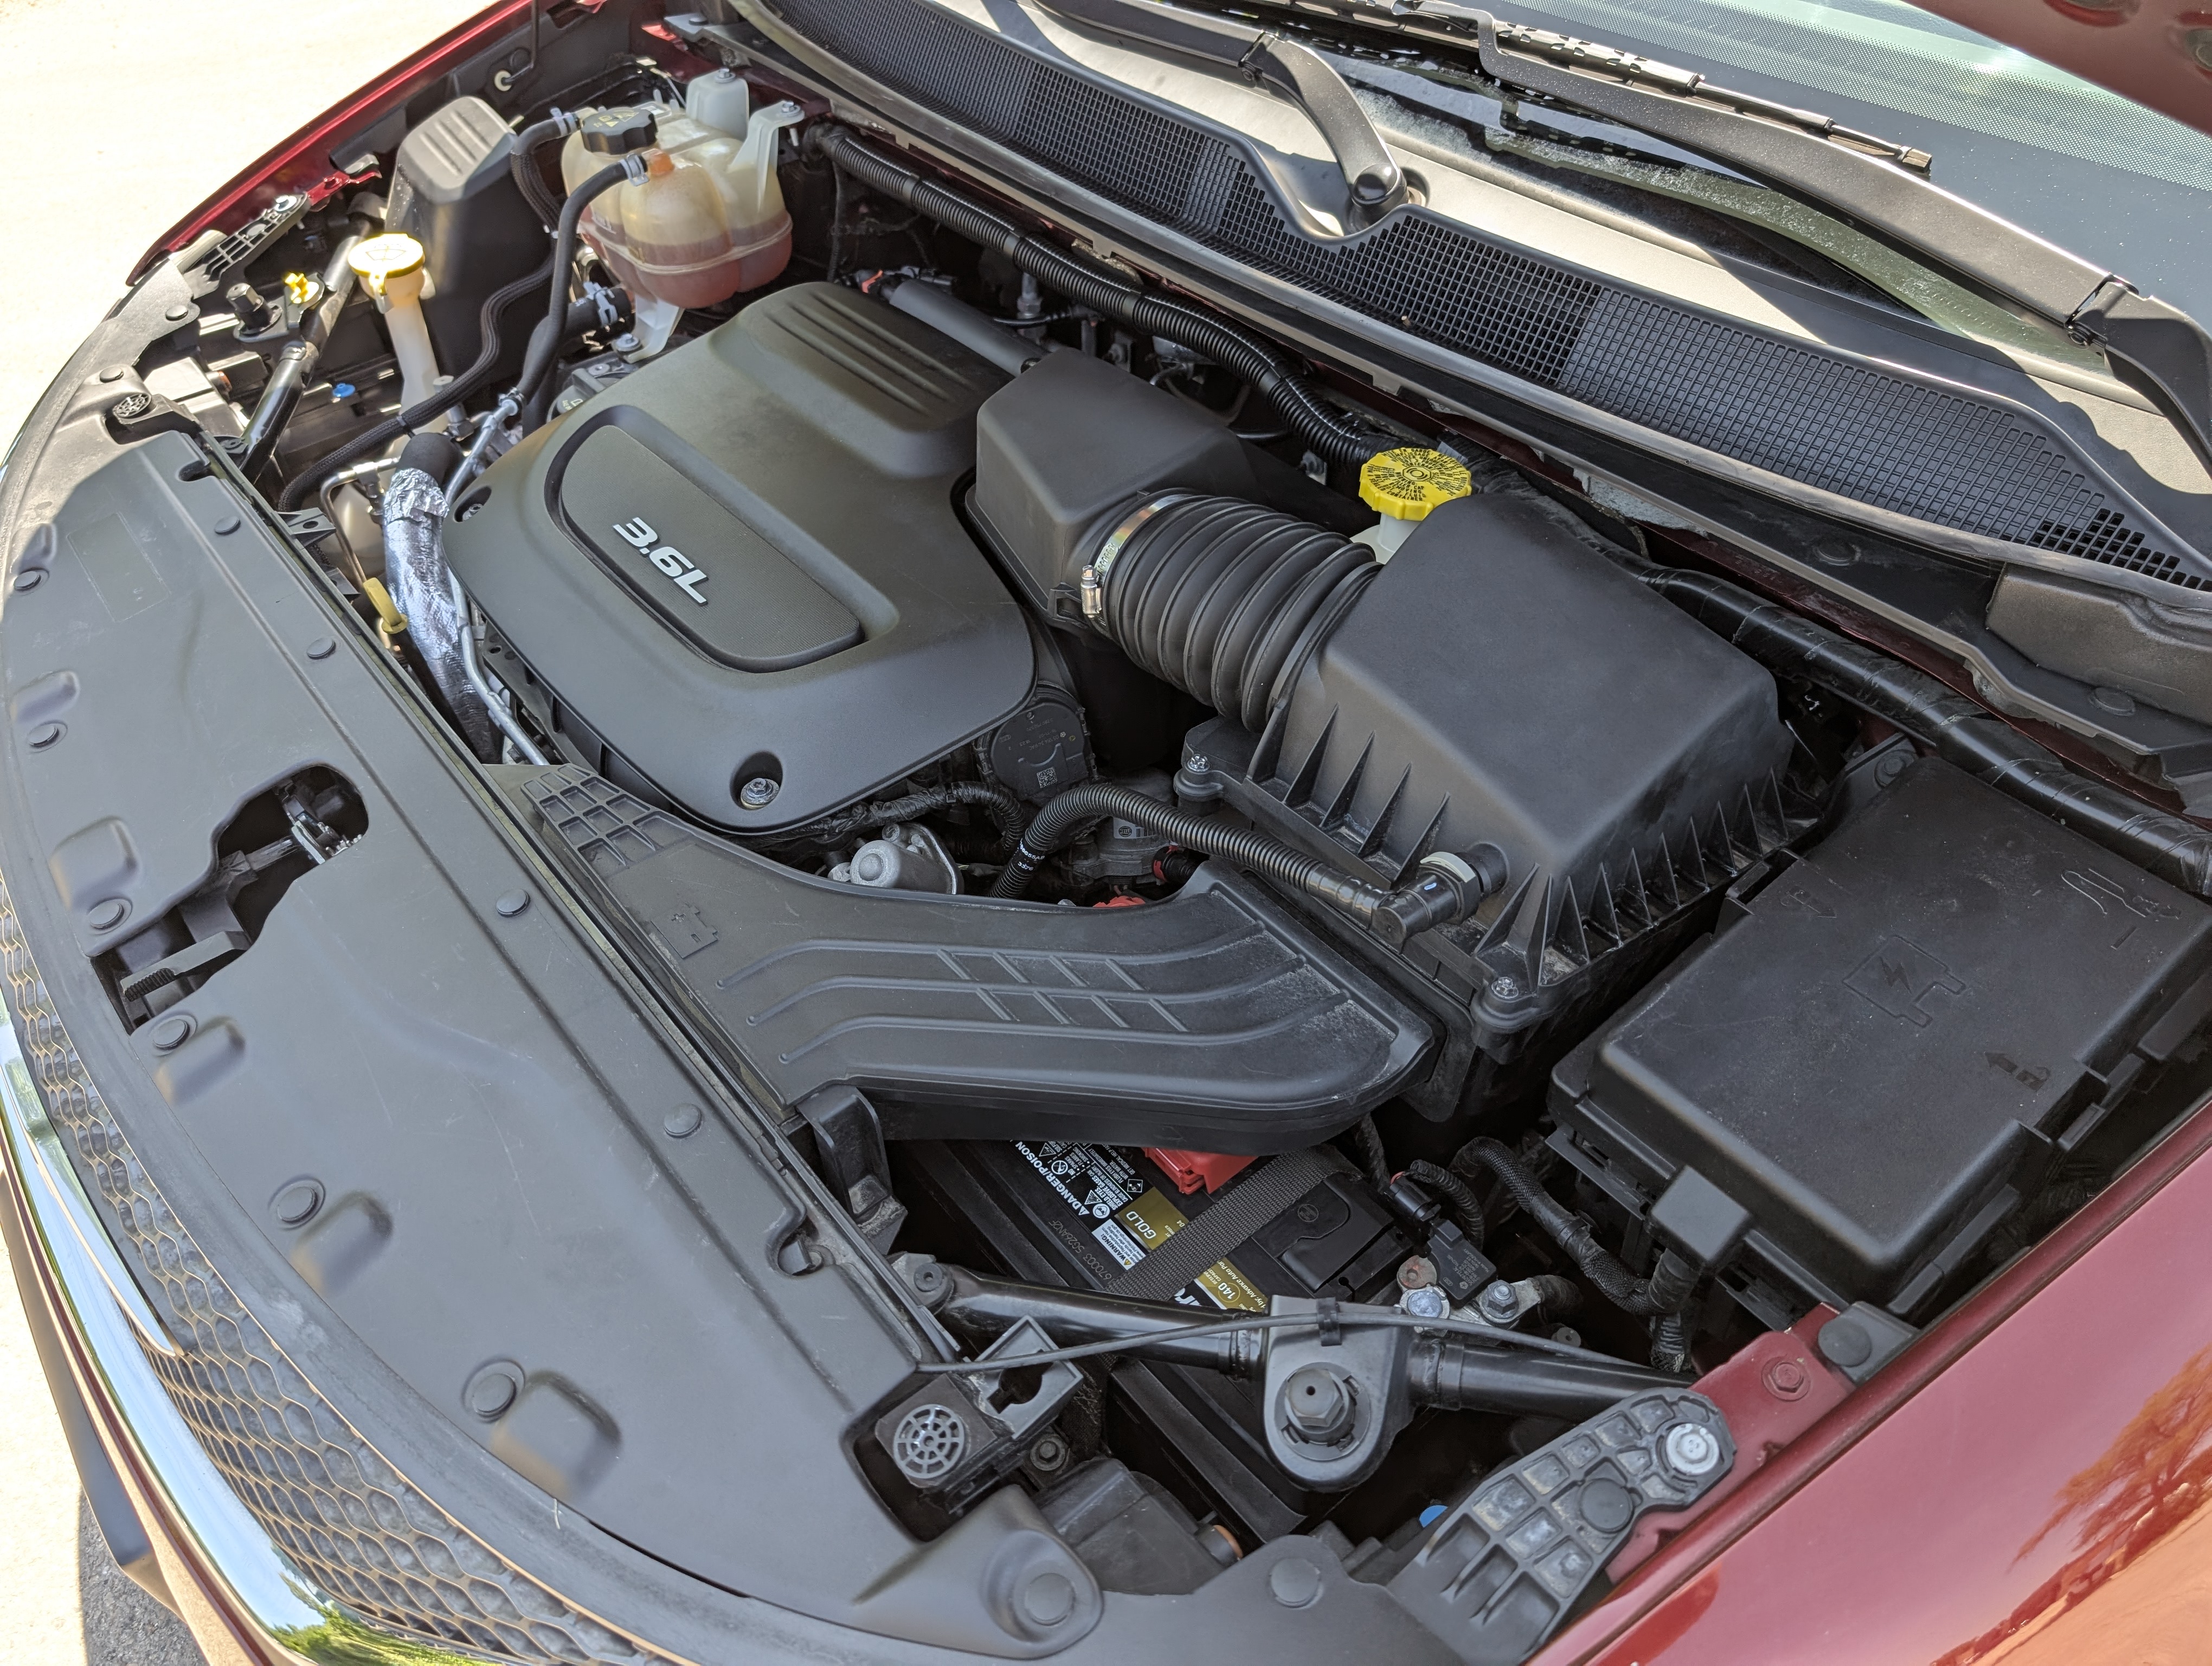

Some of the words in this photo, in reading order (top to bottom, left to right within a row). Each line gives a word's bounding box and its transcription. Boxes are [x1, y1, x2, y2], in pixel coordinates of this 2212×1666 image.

[612, 516, 709, 606] 3.6L
[1069, 1151, 1084, 1167] FLAMES
[1072, 1145, 1089, 1162] SMOKING
[1087, 1146, 1108, 1168] IMMEDIATELY
[1107, 1148, 1118, 1158] HELP
[1064, 1155, 1079, 1170] SPARKS
[1104, 1164, 1115, 1175] EYES
[1114, 1155, 1130, 1170] MEDICAL
[1014, 1139, 1083, 1210] DANGER/POISON
[1066, 1167, 1076, 1176] NO
[1086, 1168, 1095, 1177] CAN
[1111, 1171, 1124, 1184] FLUSH
[1117, 1169, 1129, 1180] WITH
[1126, 1166, 1136, 1176] GET
[1091, 1174, 1105, 1189] GASES
[1103, 1177, 1120, 1194] BLINDNESS
[1102, 1185, 1123, 1207] EXPLOSIVE
[1103, 1195, 1118, 1211] SHIELD
[1117, 1191, 1129, 1203] CAUSE
[1124, 1208, 1158, 1241] GOLD
[1099, 1232, 1127, 1261] WARNING:
[1108, 1234, 1126, 1252] Reproductive
[1116, 1237, 1126, 1246] after
[1122, 1244, 1134, 1254] hands
[1224, 1267, 1238, 1281] Auto
[1217, 1280, 1237, 1300] 140
[1235, 1277, 1257, 1299] Advance
